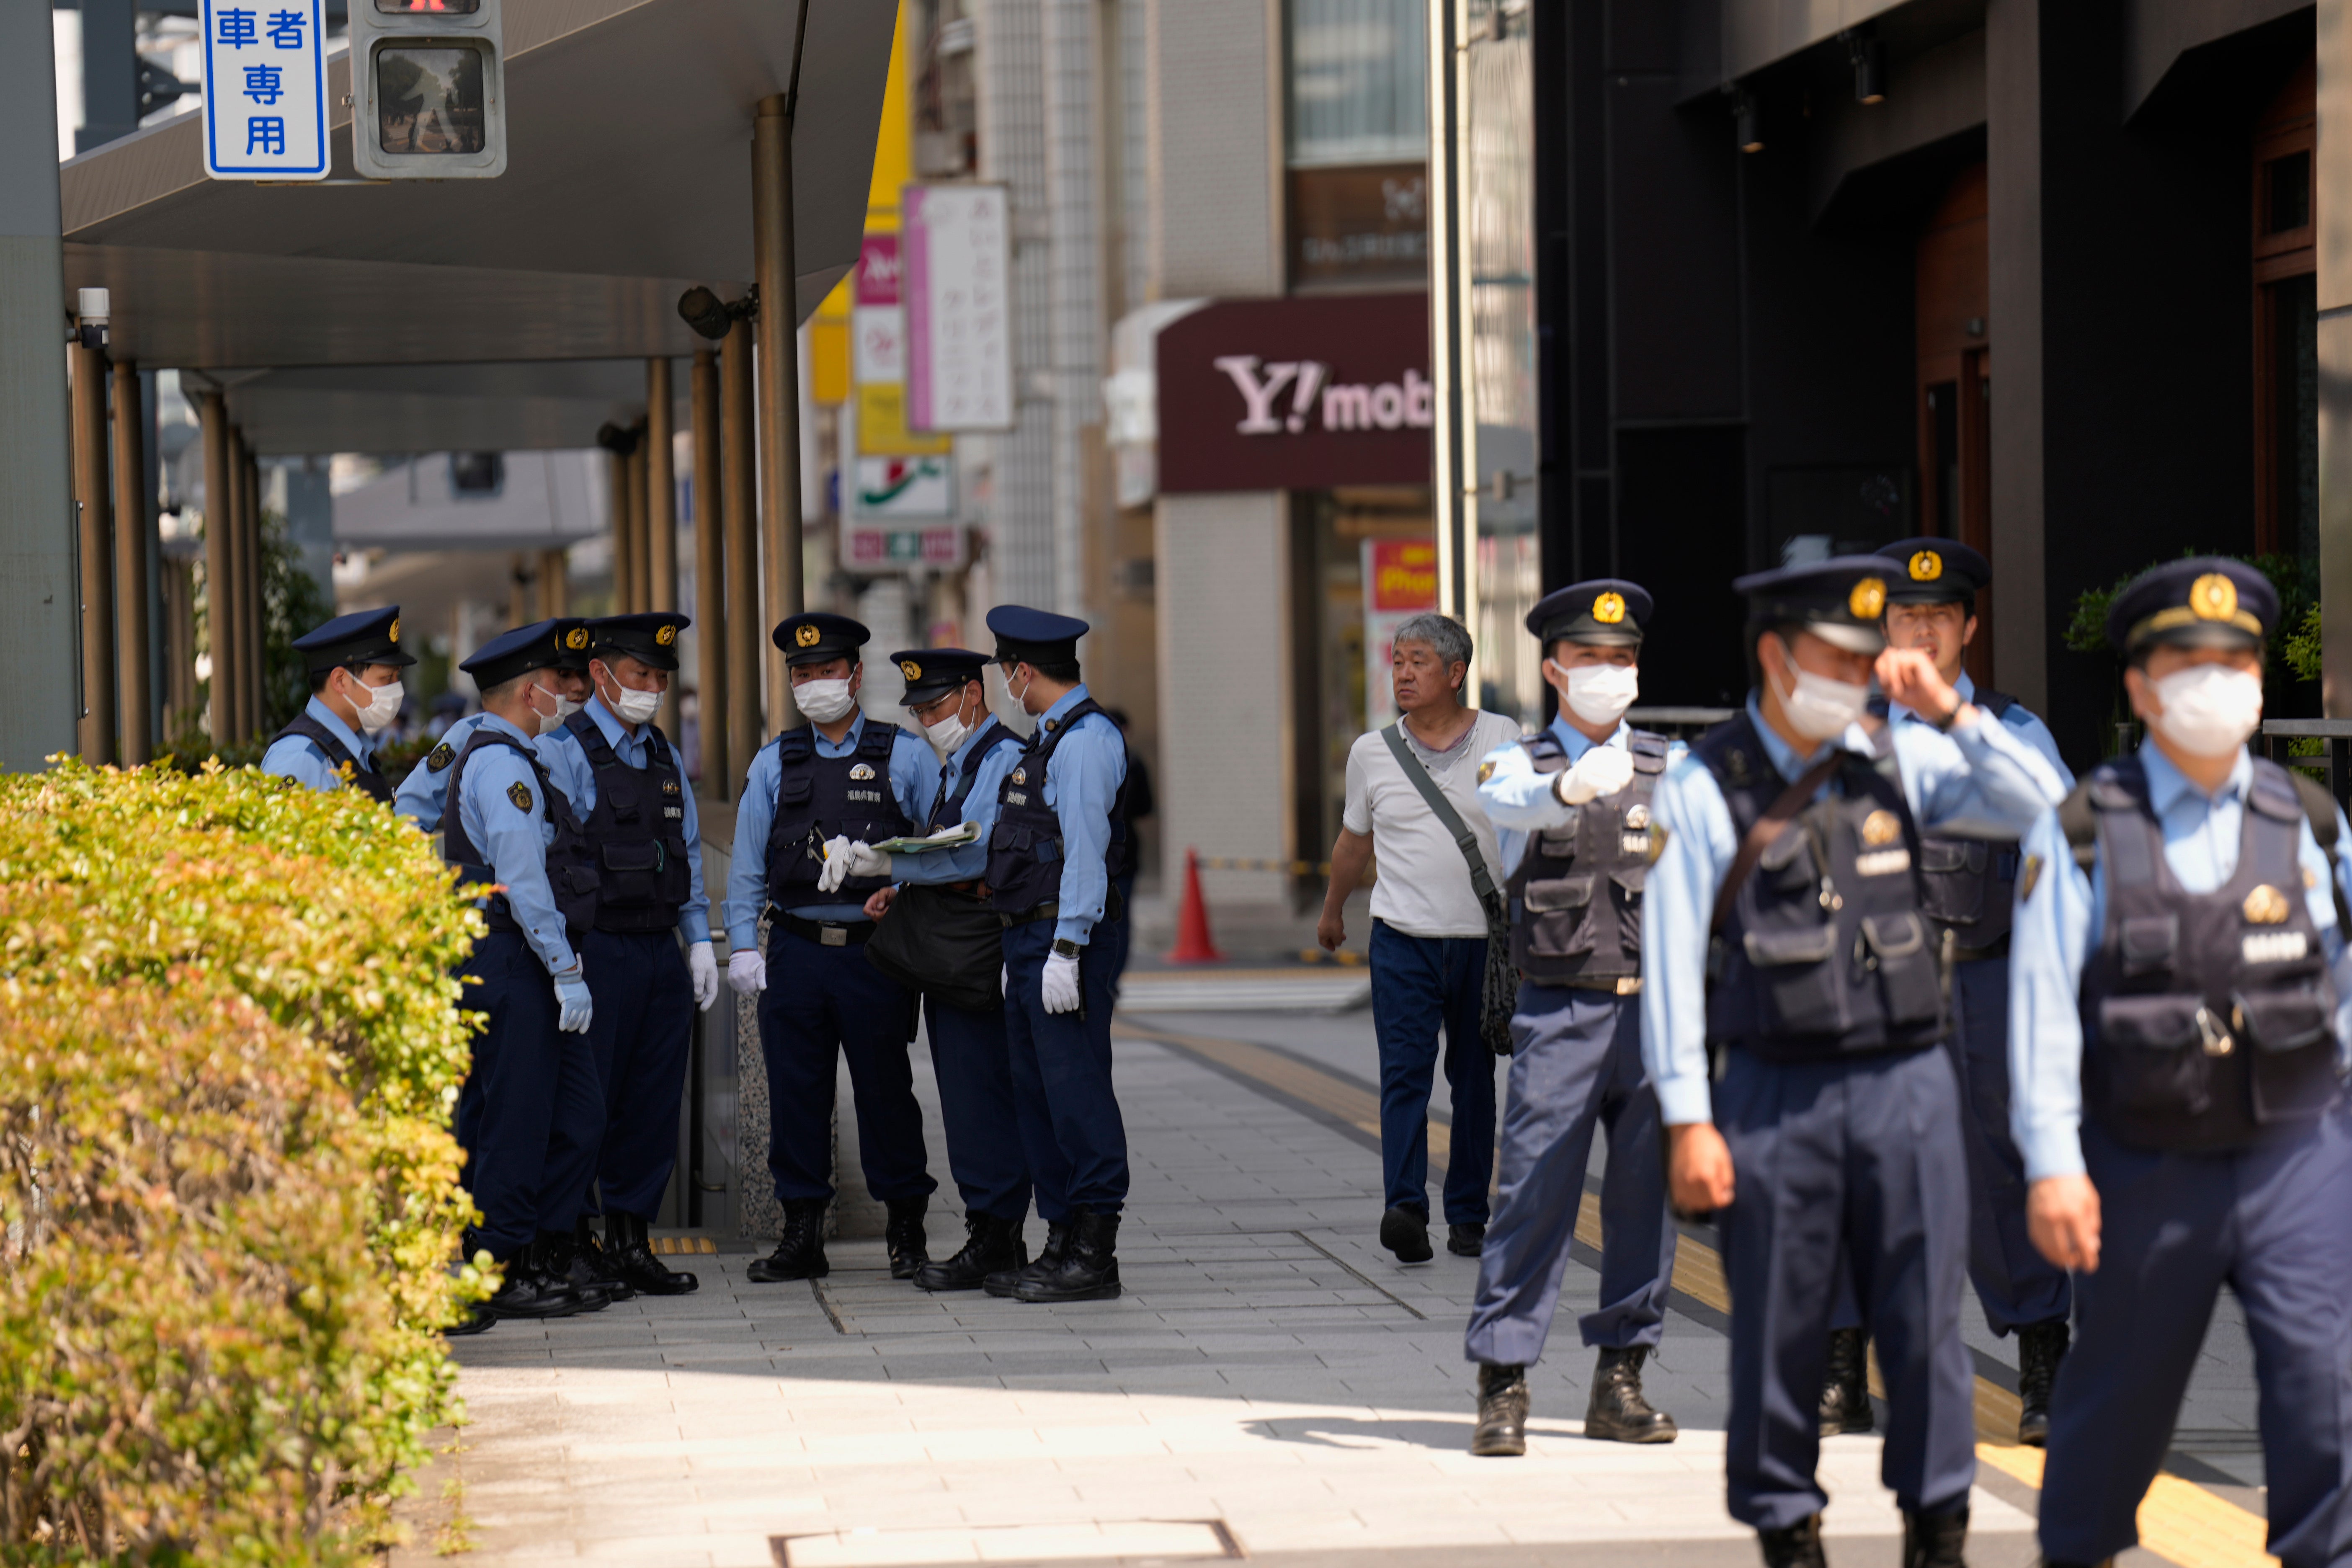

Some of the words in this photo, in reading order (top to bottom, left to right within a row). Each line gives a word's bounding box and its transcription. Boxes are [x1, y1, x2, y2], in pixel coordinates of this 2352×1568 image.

[847, 789, 881, 803] 福島県警察
